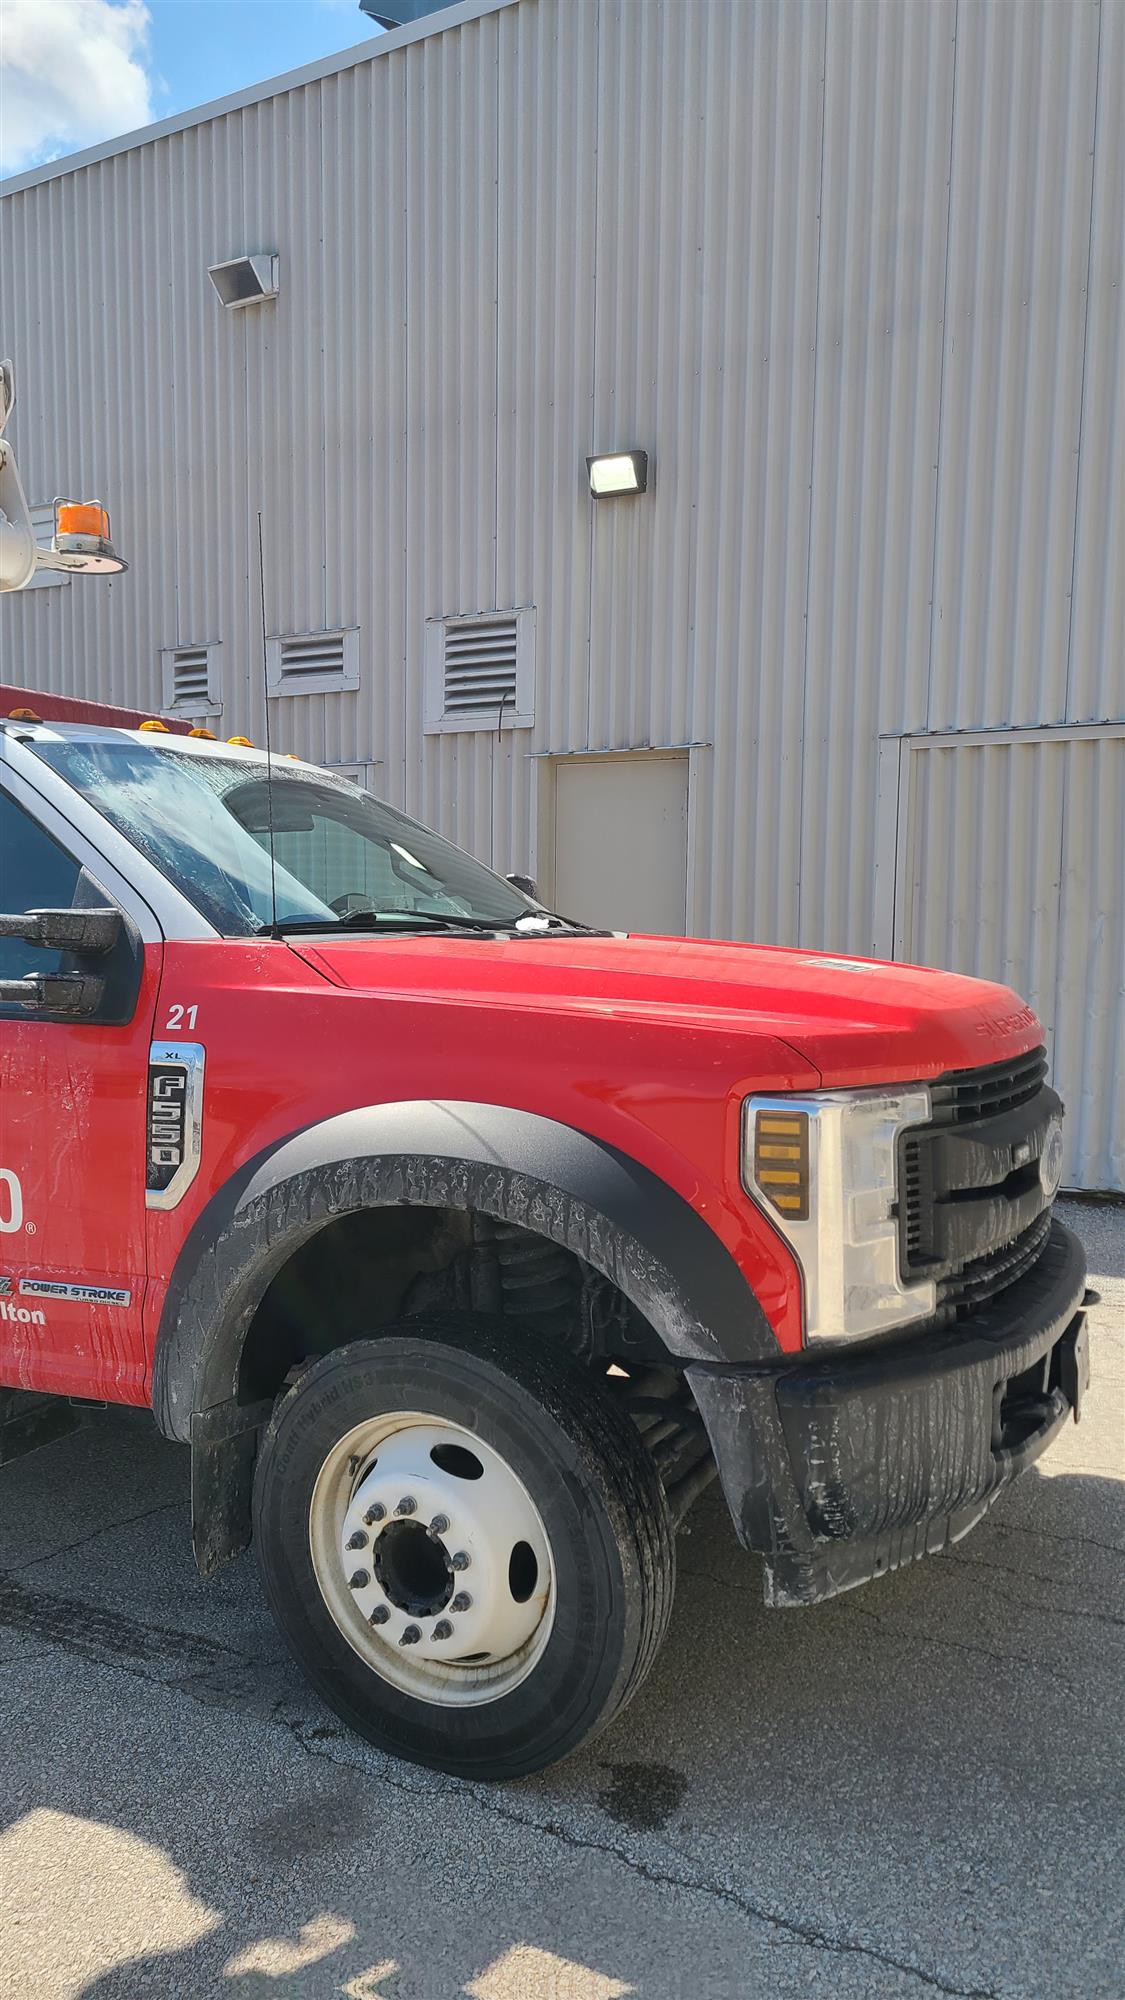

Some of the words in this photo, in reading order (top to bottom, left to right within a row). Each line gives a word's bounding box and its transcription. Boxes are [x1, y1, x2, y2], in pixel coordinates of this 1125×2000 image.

[165, 1004, 199, 1030] 21
[164, 1052, 182, 1060] XL
[151, 1075, 185, 1166] F550
[22, 1281, 68, 1295] POWER
[70, 1287, 126, 1302] STROKE
